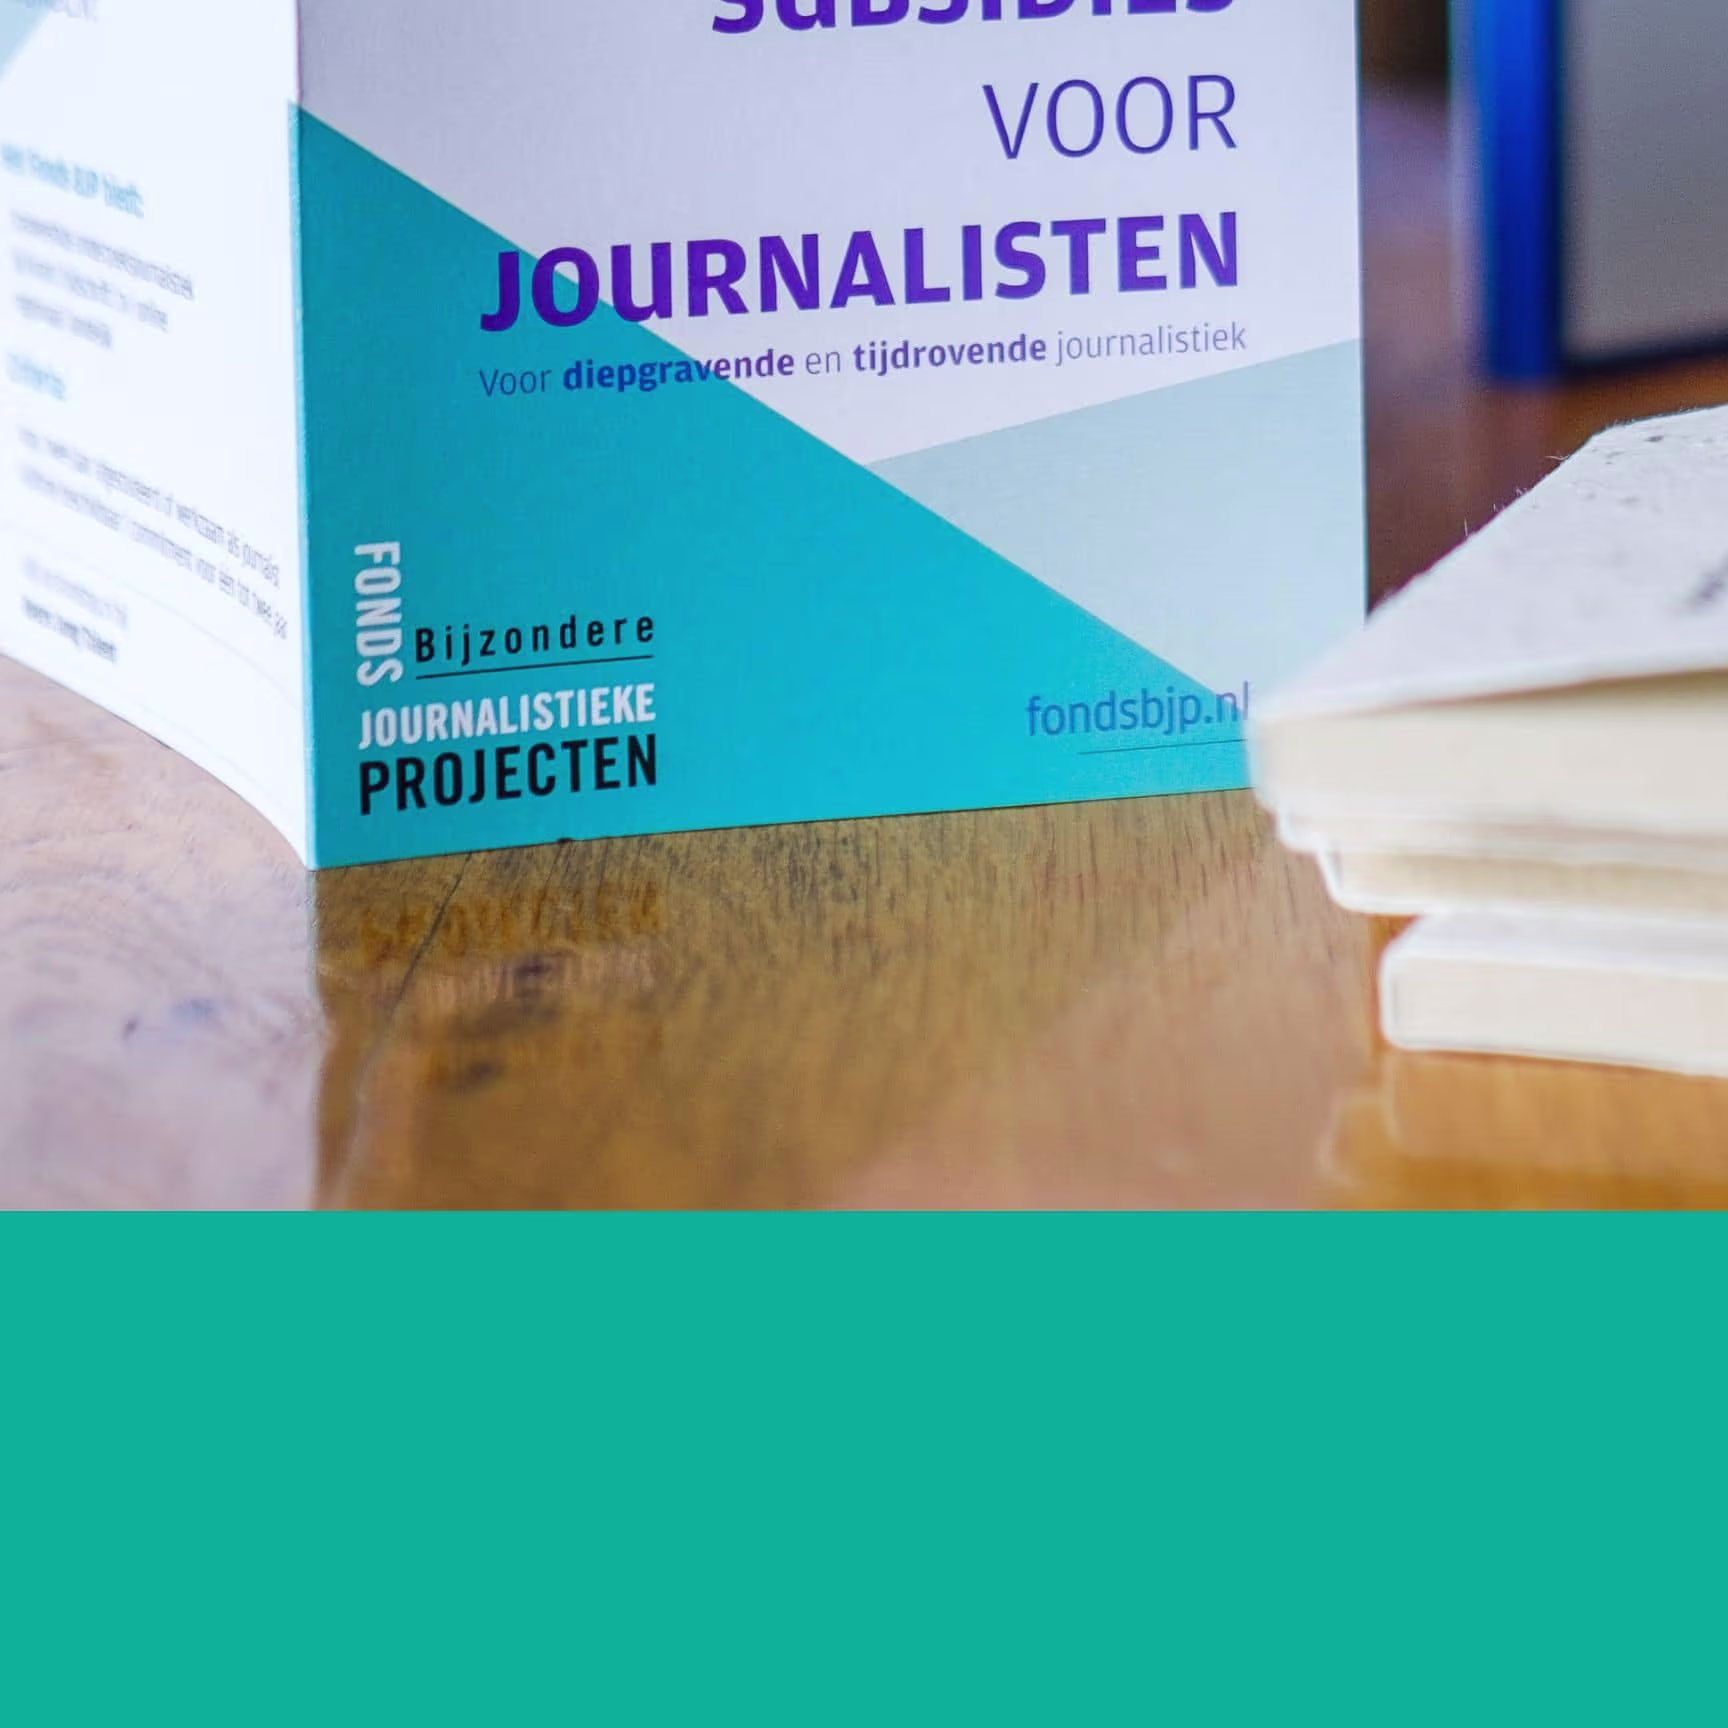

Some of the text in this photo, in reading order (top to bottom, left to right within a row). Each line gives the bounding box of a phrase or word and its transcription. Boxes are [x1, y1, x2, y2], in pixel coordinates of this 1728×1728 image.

[981, 73, 1238, 160] VOOR
[479, 210, 1238, 332] JOURNALISTEN
[478, 320, 1248, 398] Voor diepgravende en tijdrovende journalistiek
[353, 541, 402, 686] FONDS
[415, 613, 656, 664] Bijzondere
[357, 683, 656, 750] JOURNALISTIEKE
[1026, 680, 1250, 738] fondsbjp.nl
[358, 735, 658, 814] PROJECTEN
